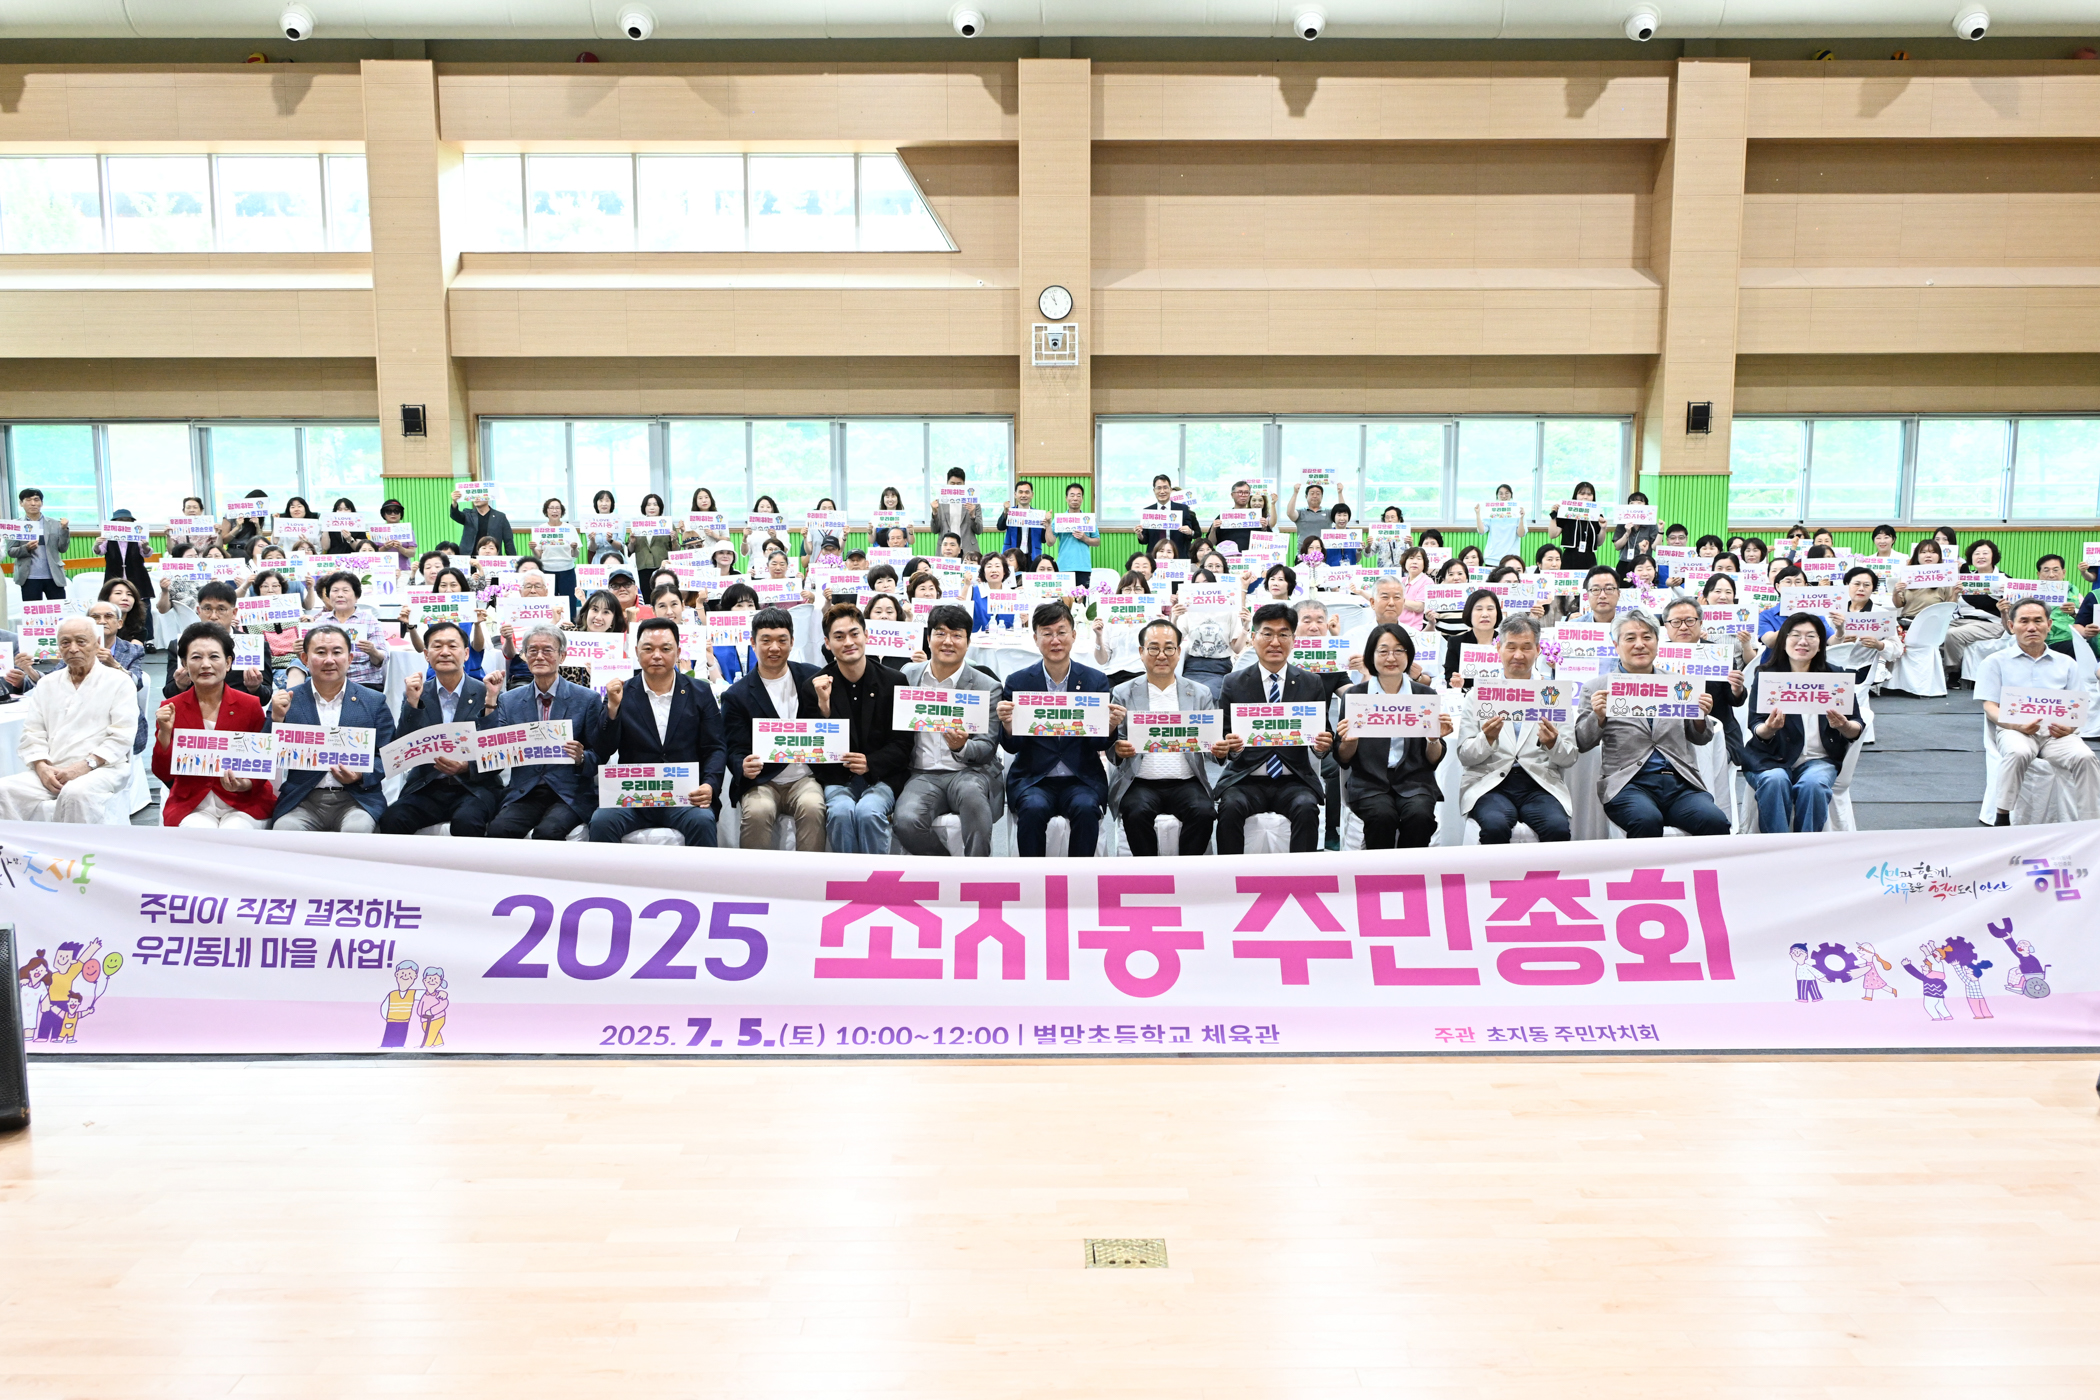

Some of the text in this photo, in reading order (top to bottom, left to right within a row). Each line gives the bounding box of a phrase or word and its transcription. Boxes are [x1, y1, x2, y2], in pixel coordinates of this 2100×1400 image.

[162, 562, 193, 570] 함께하는
[1914, 574, 1944, 582] 초지동
[2007, 582, 2037, 590] 우리마을은
[411, 595, 445, 603] 공감으로
[1427, 589, 1462, 598] 함께하는
[238, 599, 270, 610] 우리마을은
[1193, 596, 1227, 605] 초지동
[1797, 600, 1833, 608] 초지동
[24, 604, 61, 615] 우리마을은
[268, 608, 300, 619] 우리손으로
[423, 604, 458, 612] 우리마을
[710, 616, 746, 626] 우리마을은
[1703, 611, 1732, 620] 께하는
[22, 627, 56, 636] 공감으
[1845, 623, 1881, 631] 초지동
[1558, 629, 1604, 641] 함께하는
[1294, 639, 1349, 648] 감으로 잇는
[567, 646, 605, 658] 초지동
[1293, 651, 1336, 660] 우리마을
[1463, 651, 1501, 662] 함께하
[1659, 648, 1691, 658] 리마을은
[1687, 665, 1729, 676] 우리손으로
[1478, 688, 1534, 702] 함께하는
[1611, 682, 1668, 697] 함께하는
[899, 689, 979, 704] 공감으로 잇는
[1018, 695, 1099, 706] 공감으로 잇는
[1780, 691, 1831, 703] 초지동
[915, 704, 964, 717] 우리마을
[1034, 709, 1084, 719] 우리마을
[1236, 706, 1316, 716] 공감으로 잇는
[1525, 709, 1566, 722] 초지동
[1658, 704, 1700, 717] 초지동
[2020, 704, 2068, 716] 초지동
[1133, 714, 1214, 724] 공감으로 잇는
[1252, 719, 1301, 730] 우리마을
[1367, 713, 1419, 726] 초지동
[758, 722, 839, 733] 공감으로 잇는
[1149, 727, 1198, 737] 우리마을
[177, 735, 229, 750] 우리마을은
[275, 729, 325, 745] 우리마을은
[416, 733, 448, 746] LOVE
[477, 729, 527, 748] 우리마을은
[774, 736, 824, 746] 우리마을
[404, 740, 457, 761] 초지동
[221, 757, 272, 773] 우리손으로
[319, 752, 369, 767] 우리손으로
[605, 767, 689, 778] 공감으로 잇는
[621, 780, 673, 791] 우리마을
[140, 893, 422, 929] 주민이 직접 결정하는
[482, 868, 1736, 998] 2025 초지동 주민총회
[131, 936, 396, 969] 우리동네 마을 사업!
[599, 1025, 676, 1046] 2025.
[685, 1017, 722, 1048] 7.
[835, 1025, 1010, 1046] 10:00~12:00
[1033, 1023, 1193, 1046] 별망초등학교
[1201, 1023, 1280, 1046] 체육관
[1434, 1024, 1660, 1043] 주관 초지동 주민자치회
